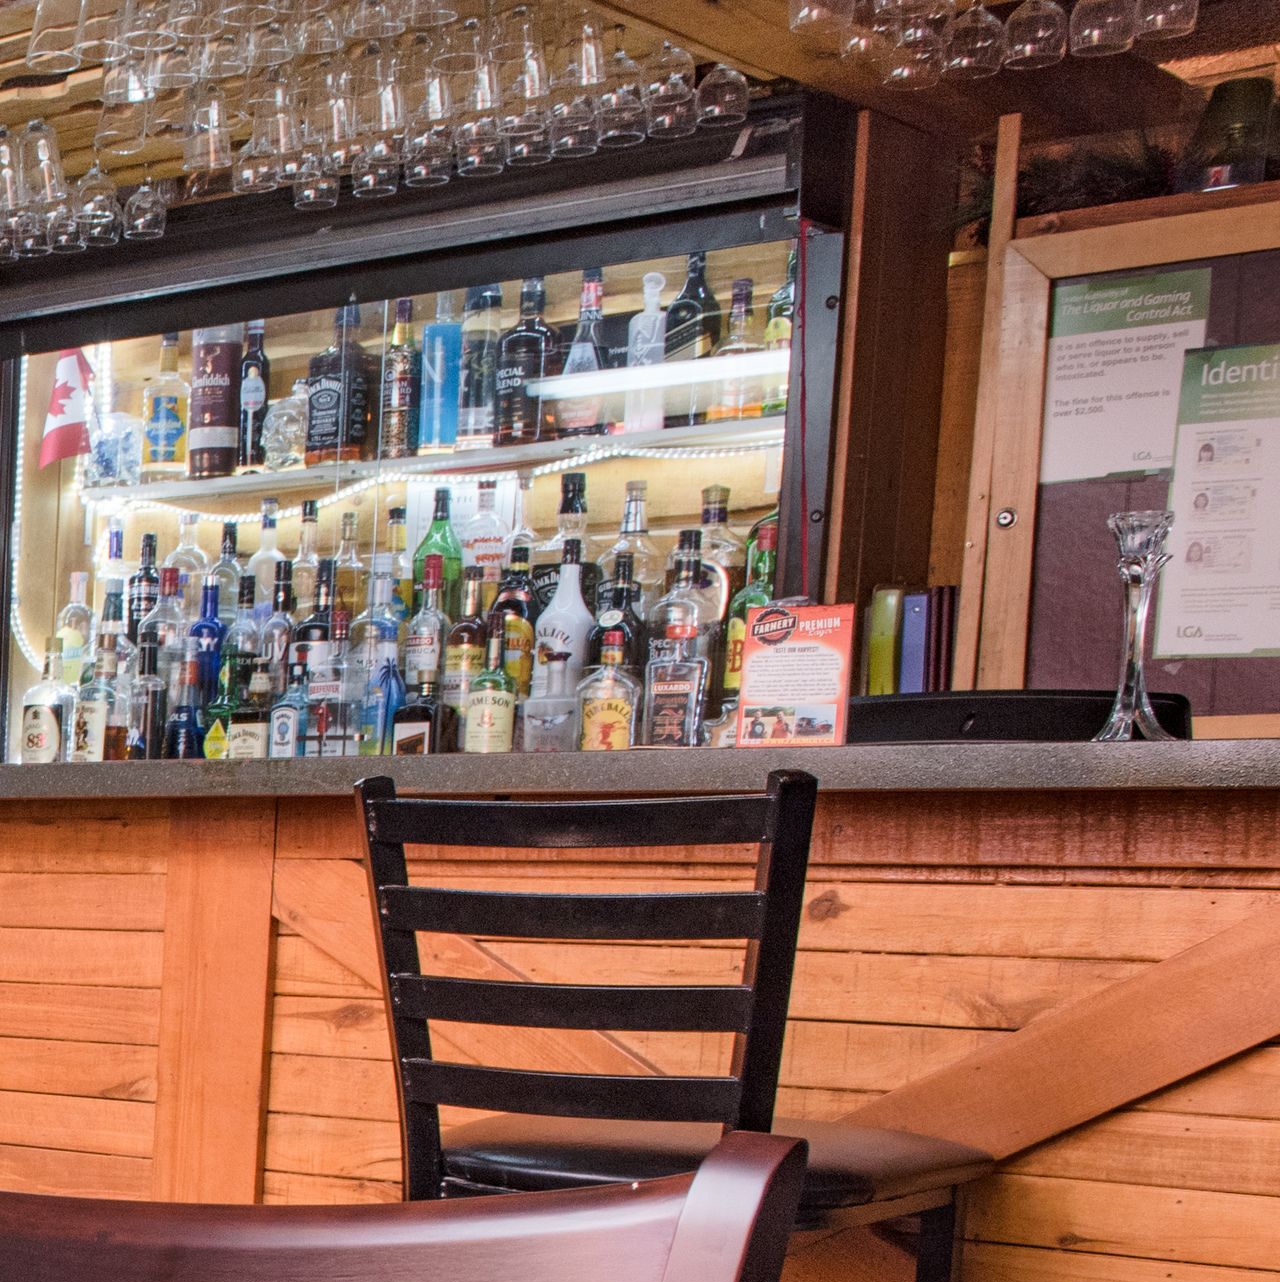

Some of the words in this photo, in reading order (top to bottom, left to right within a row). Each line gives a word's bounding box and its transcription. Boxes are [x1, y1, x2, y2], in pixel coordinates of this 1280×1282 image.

[1061, 304, 1082, 316] The
[1083, 301, 1119, 315] Liquor
[1120, 295, 1141, 308] and
[1143, 290, 1191, 305] Gaming
[1126, 307, 1171, 322] Control
[1172, 304, 1193, 316] Act
[1088, 338, 1122, 348] offence
[1172, 329, 1189, 337] sell
[1068, 352, 1093, 360] serve
[1142, 342, 1175, 352] person
[1101, 357, 1138, 367] appears
[1139, 354, 1149, 362] to
[1125, 391, 1158, 400] offence
[754, 618, 795, 635] FARMERY
[799, 617, 841, 632] PREMIUM
[1177, 626, 1203, 638] LGA
[653, 684, 691, 692] LUXARDO
[585, 702, 631, 720] FIREBALL
[26, 733, 46, 749] 83
